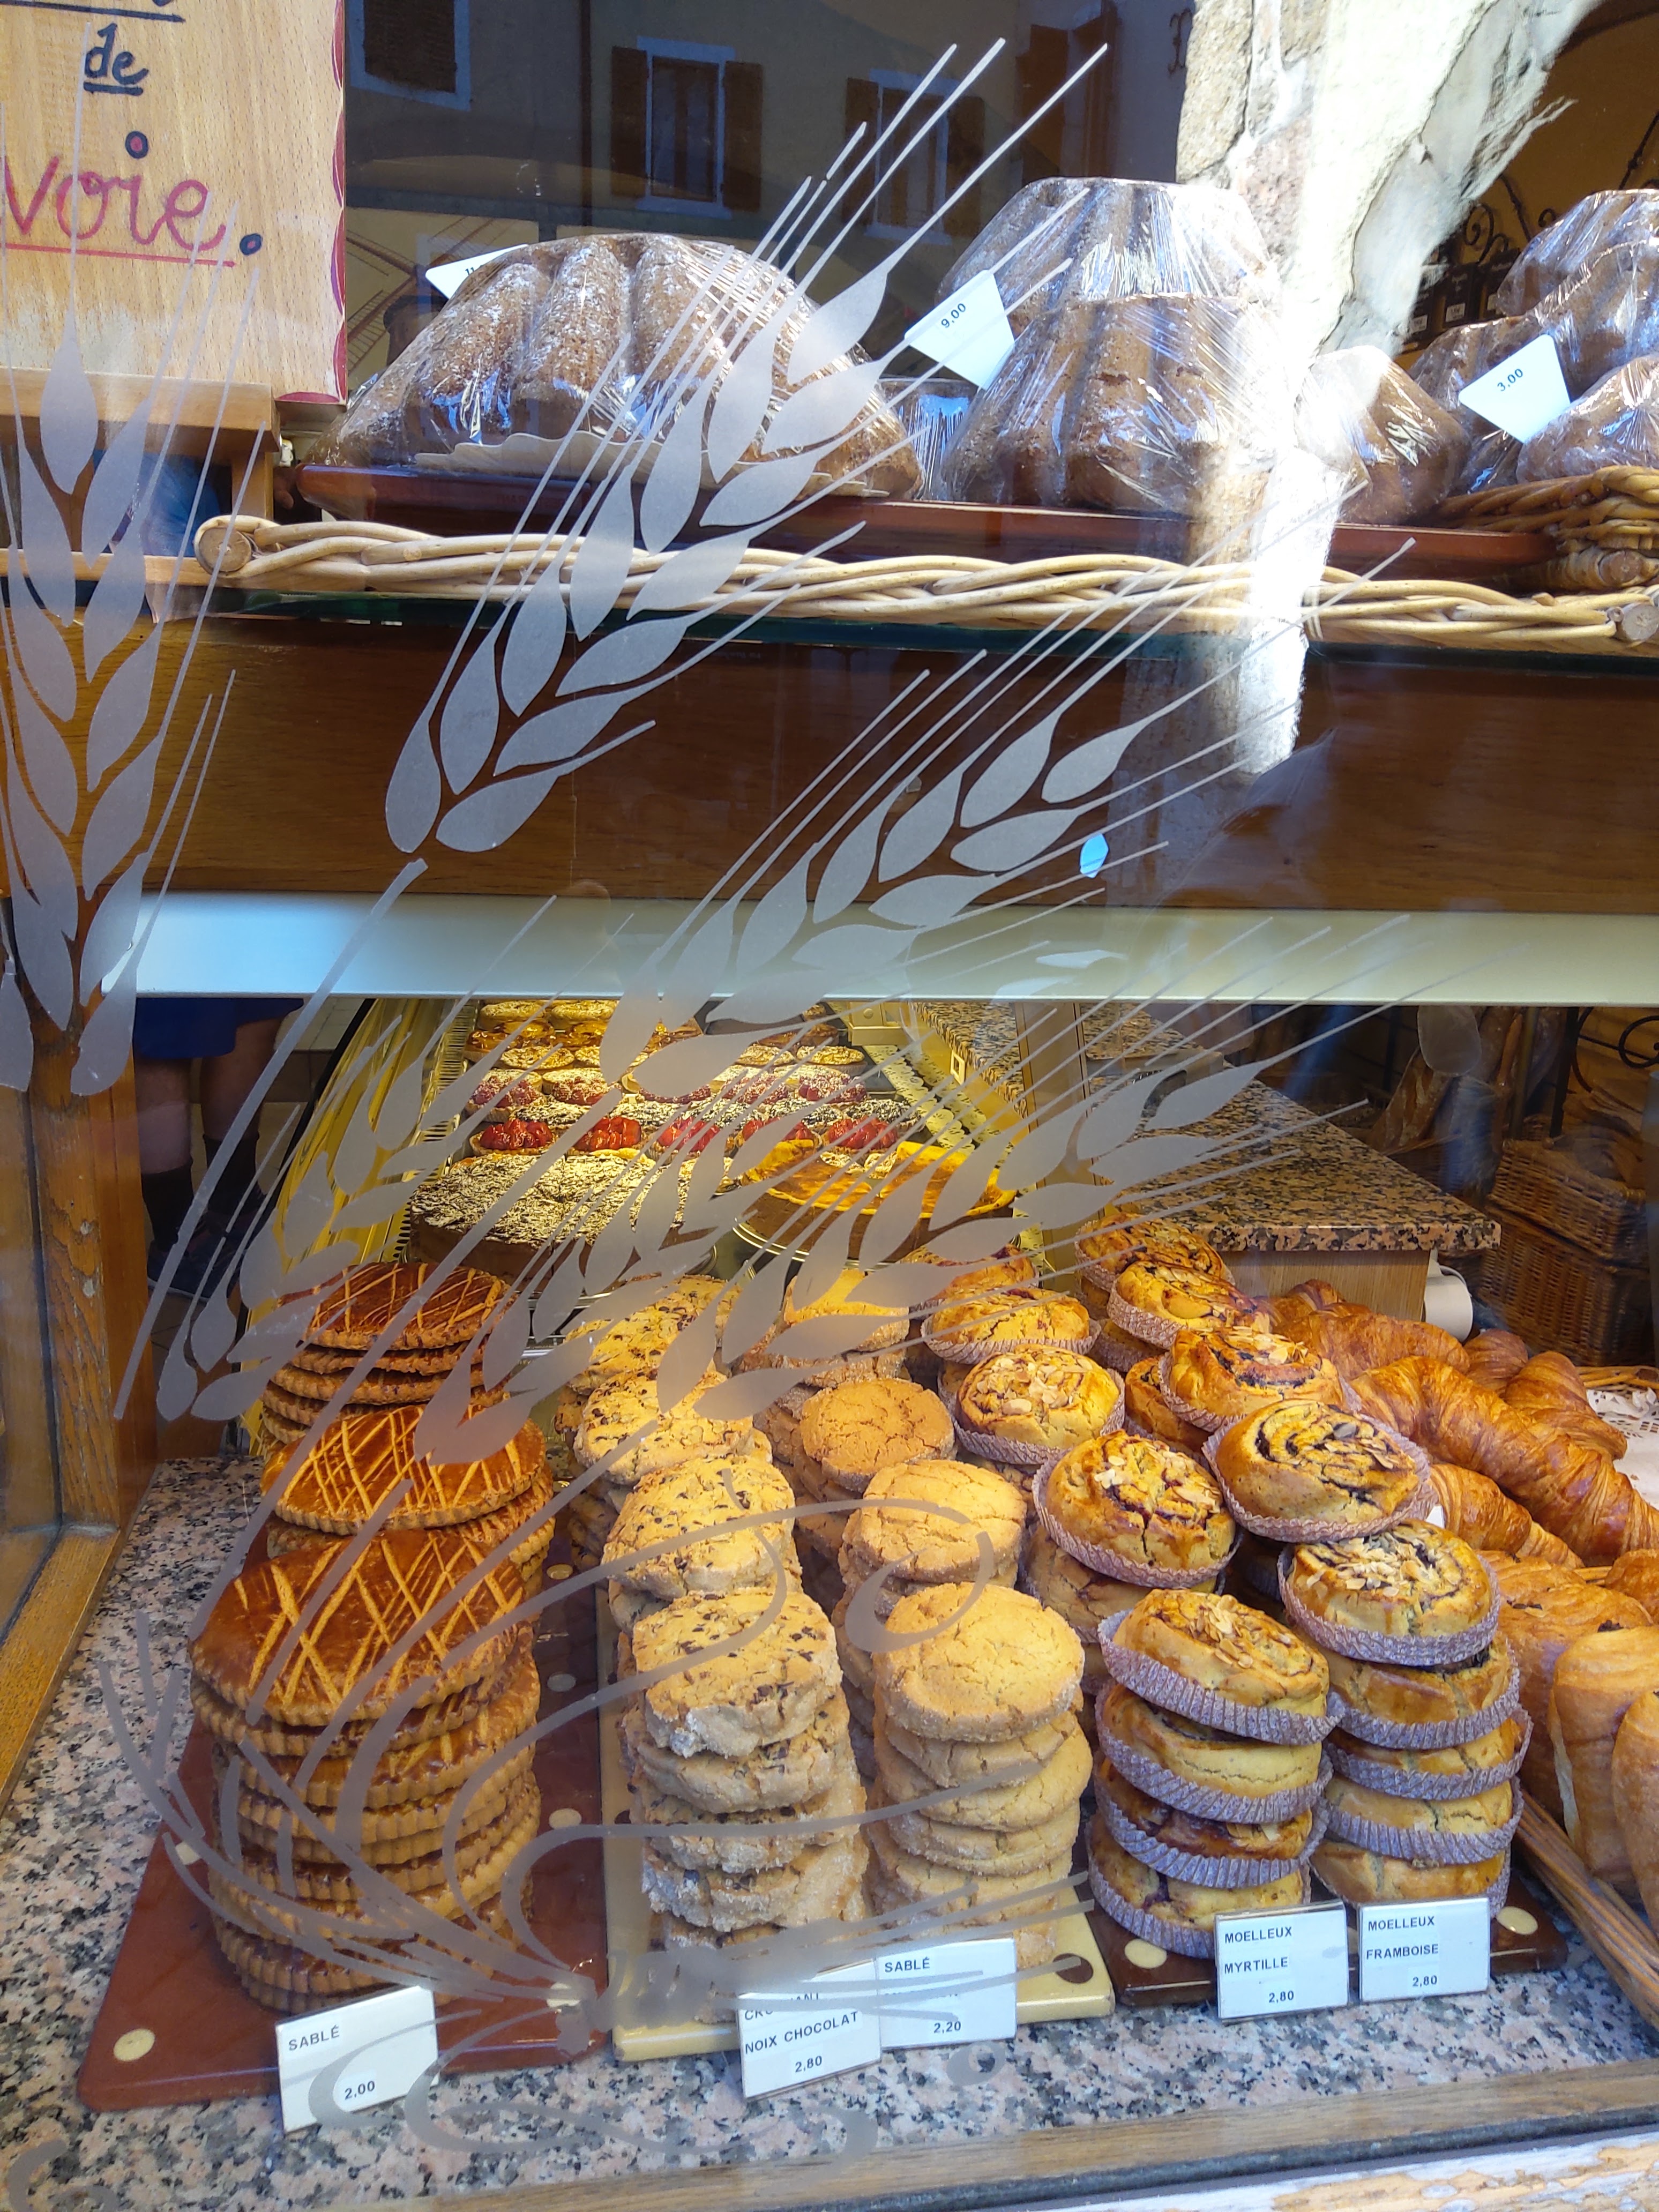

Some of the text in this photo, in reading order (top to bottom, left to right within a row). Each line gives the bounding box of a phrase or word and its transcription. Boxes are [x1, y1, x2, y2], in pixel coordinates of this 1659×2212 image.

[84, 23, 149, 85] de
[941, 303, 966, 328] 9,00
[1497, 368, 1523, 392] 3,00
[1368, 1916, 1434, 1932] MOELLEUX
[1224, 1926, 1292, 1944] MOELLEUX
[1366, 1943, 1439, 1960] FRAMBOISE
[885, 1956, 930, 1973] SABLÉ
[1224, 1956, 1288, 1975] MYRTILLE
[1412, 1975, 1437, 1987] 2,80
[1268, 1990, 1294, 2004] 2,80
[745, 2010, 858, 2054] NOIX CHOCOLAT
[933, 2021, 962, 2034] 2,20
[288, 2024, 340, 2051] SABLÉ
[795, 2055, 823, 2073] 2,80
[344, 2080, 375, 2101] 2,00
